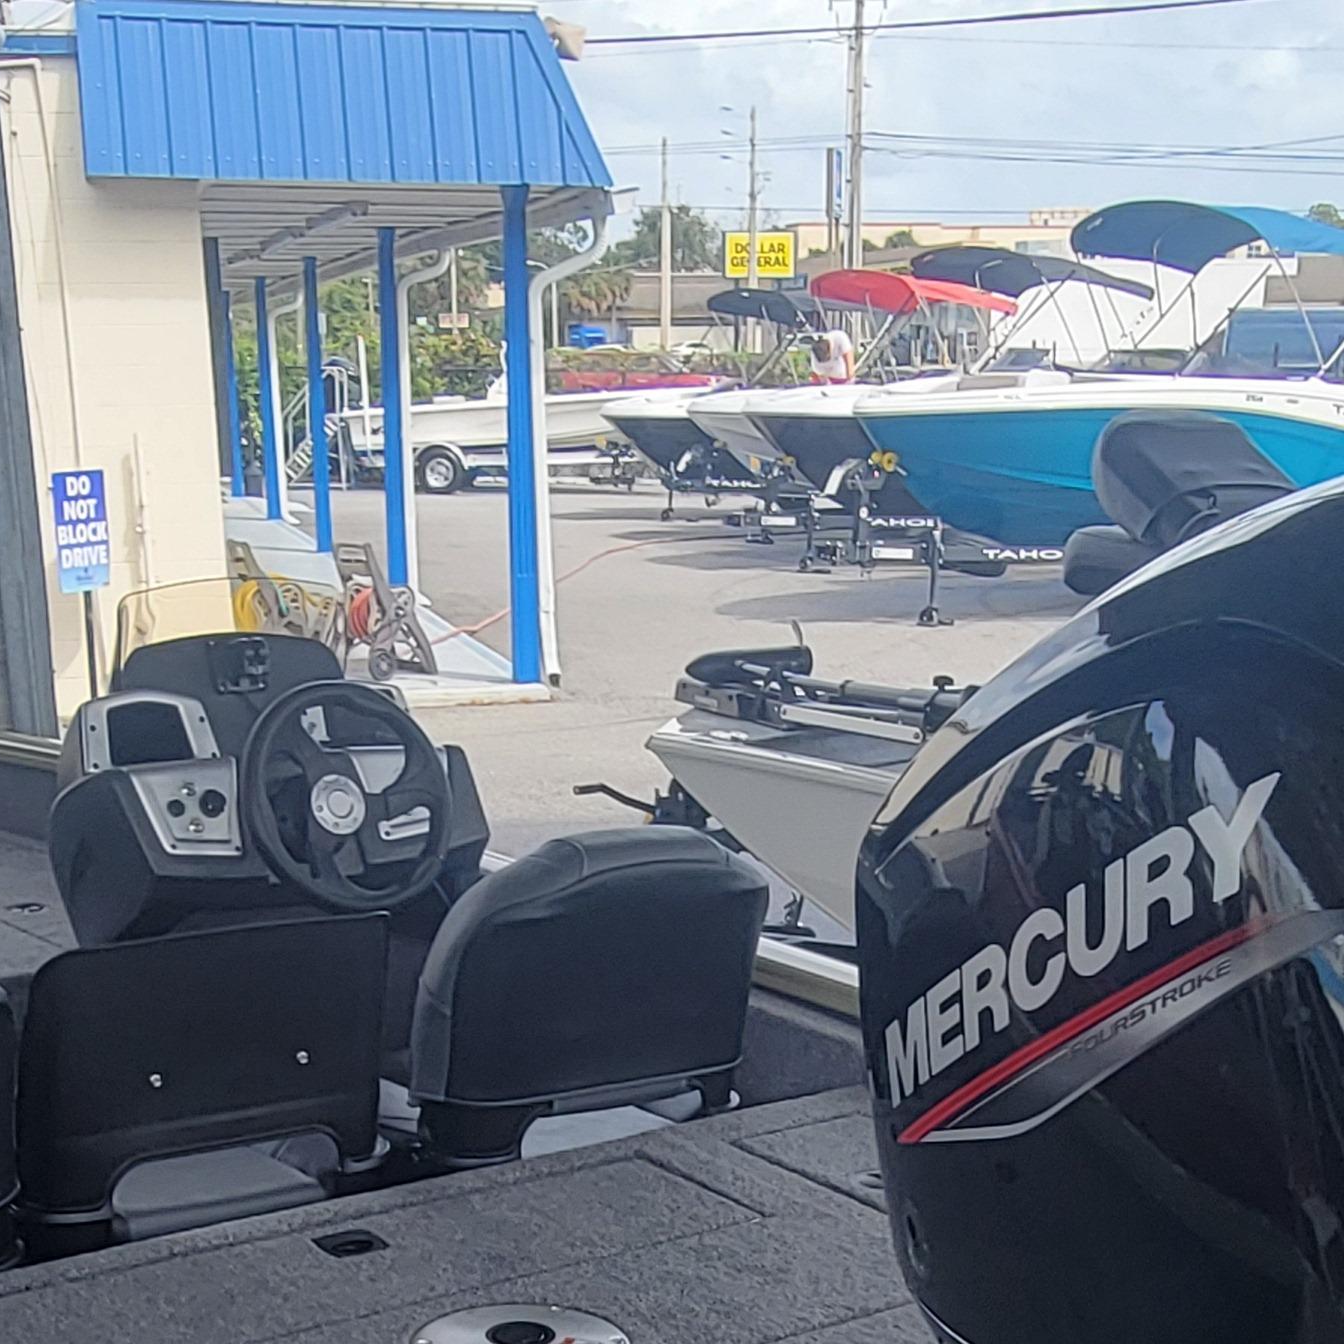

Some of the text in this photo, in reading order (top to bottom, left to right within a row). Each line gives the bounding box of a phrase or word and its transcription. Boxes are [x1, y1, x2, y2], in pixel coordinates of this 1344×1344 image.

[735, 241, 786, 254] DOLAR
[731, 255, 789, 268] GEERAL
[65, 475, 91, 497] DO
[63, 499, 97, 520] NOT
[58, 520, 108, 546] BLOCK
[60, 544, 108, 569] DRIVE
[884, 771, 1282, 1109] MERCURY
[1063, 957, 1233, 1062] FOURSTROKE
